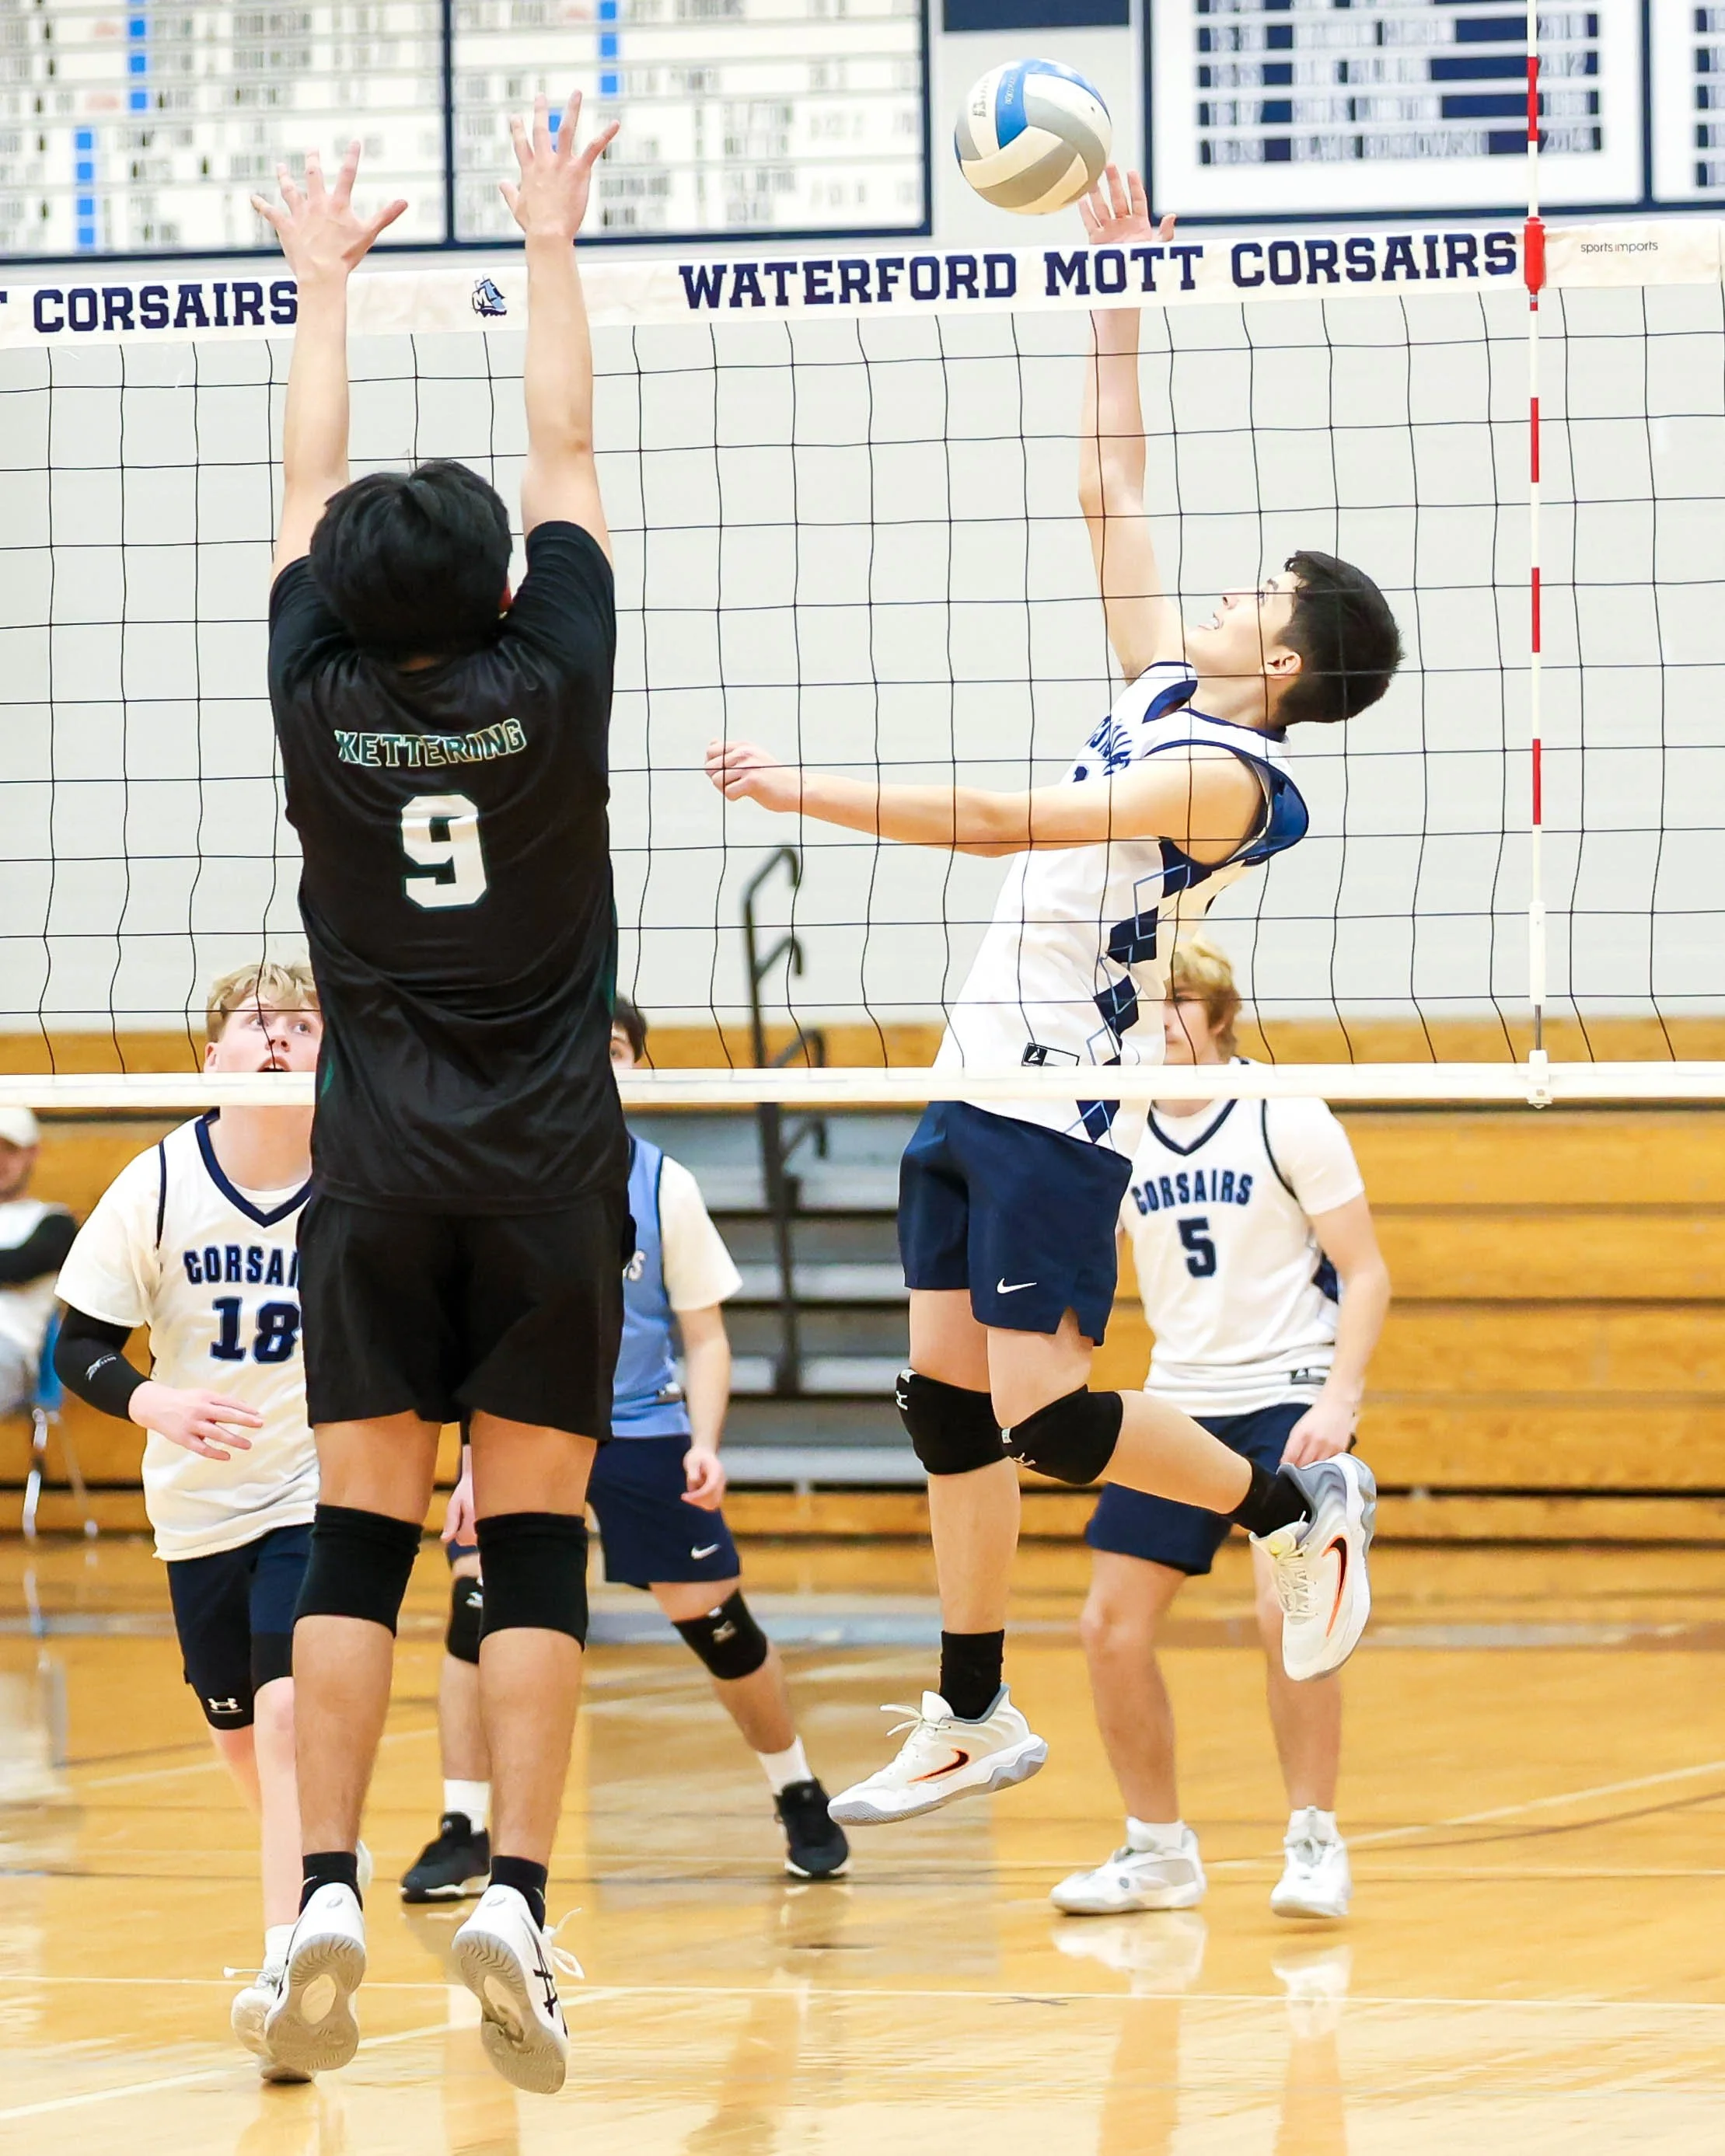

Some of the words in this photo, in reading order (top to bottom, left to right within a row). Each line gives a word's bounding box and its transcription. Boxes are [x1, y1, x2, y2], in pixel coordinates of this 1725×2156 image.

[678, 253, 1016, 309] WATERFORD
[1043, 246, 1203, 296] MOTT
[1231, 232, 1517, 288] CORSAIRS
[1580, 242, 1613, 254] sports
[33, 281, 298, 333] CORSAIRS
[333, 717, 527, 767] KETTERING
[400, 794, 487, 909] 9
[1131, 1168, 1253, 1216] CORSAIRS
[1177, 1216, 1217, 1278] 5
[211, 1296, 302, 1364] 18
